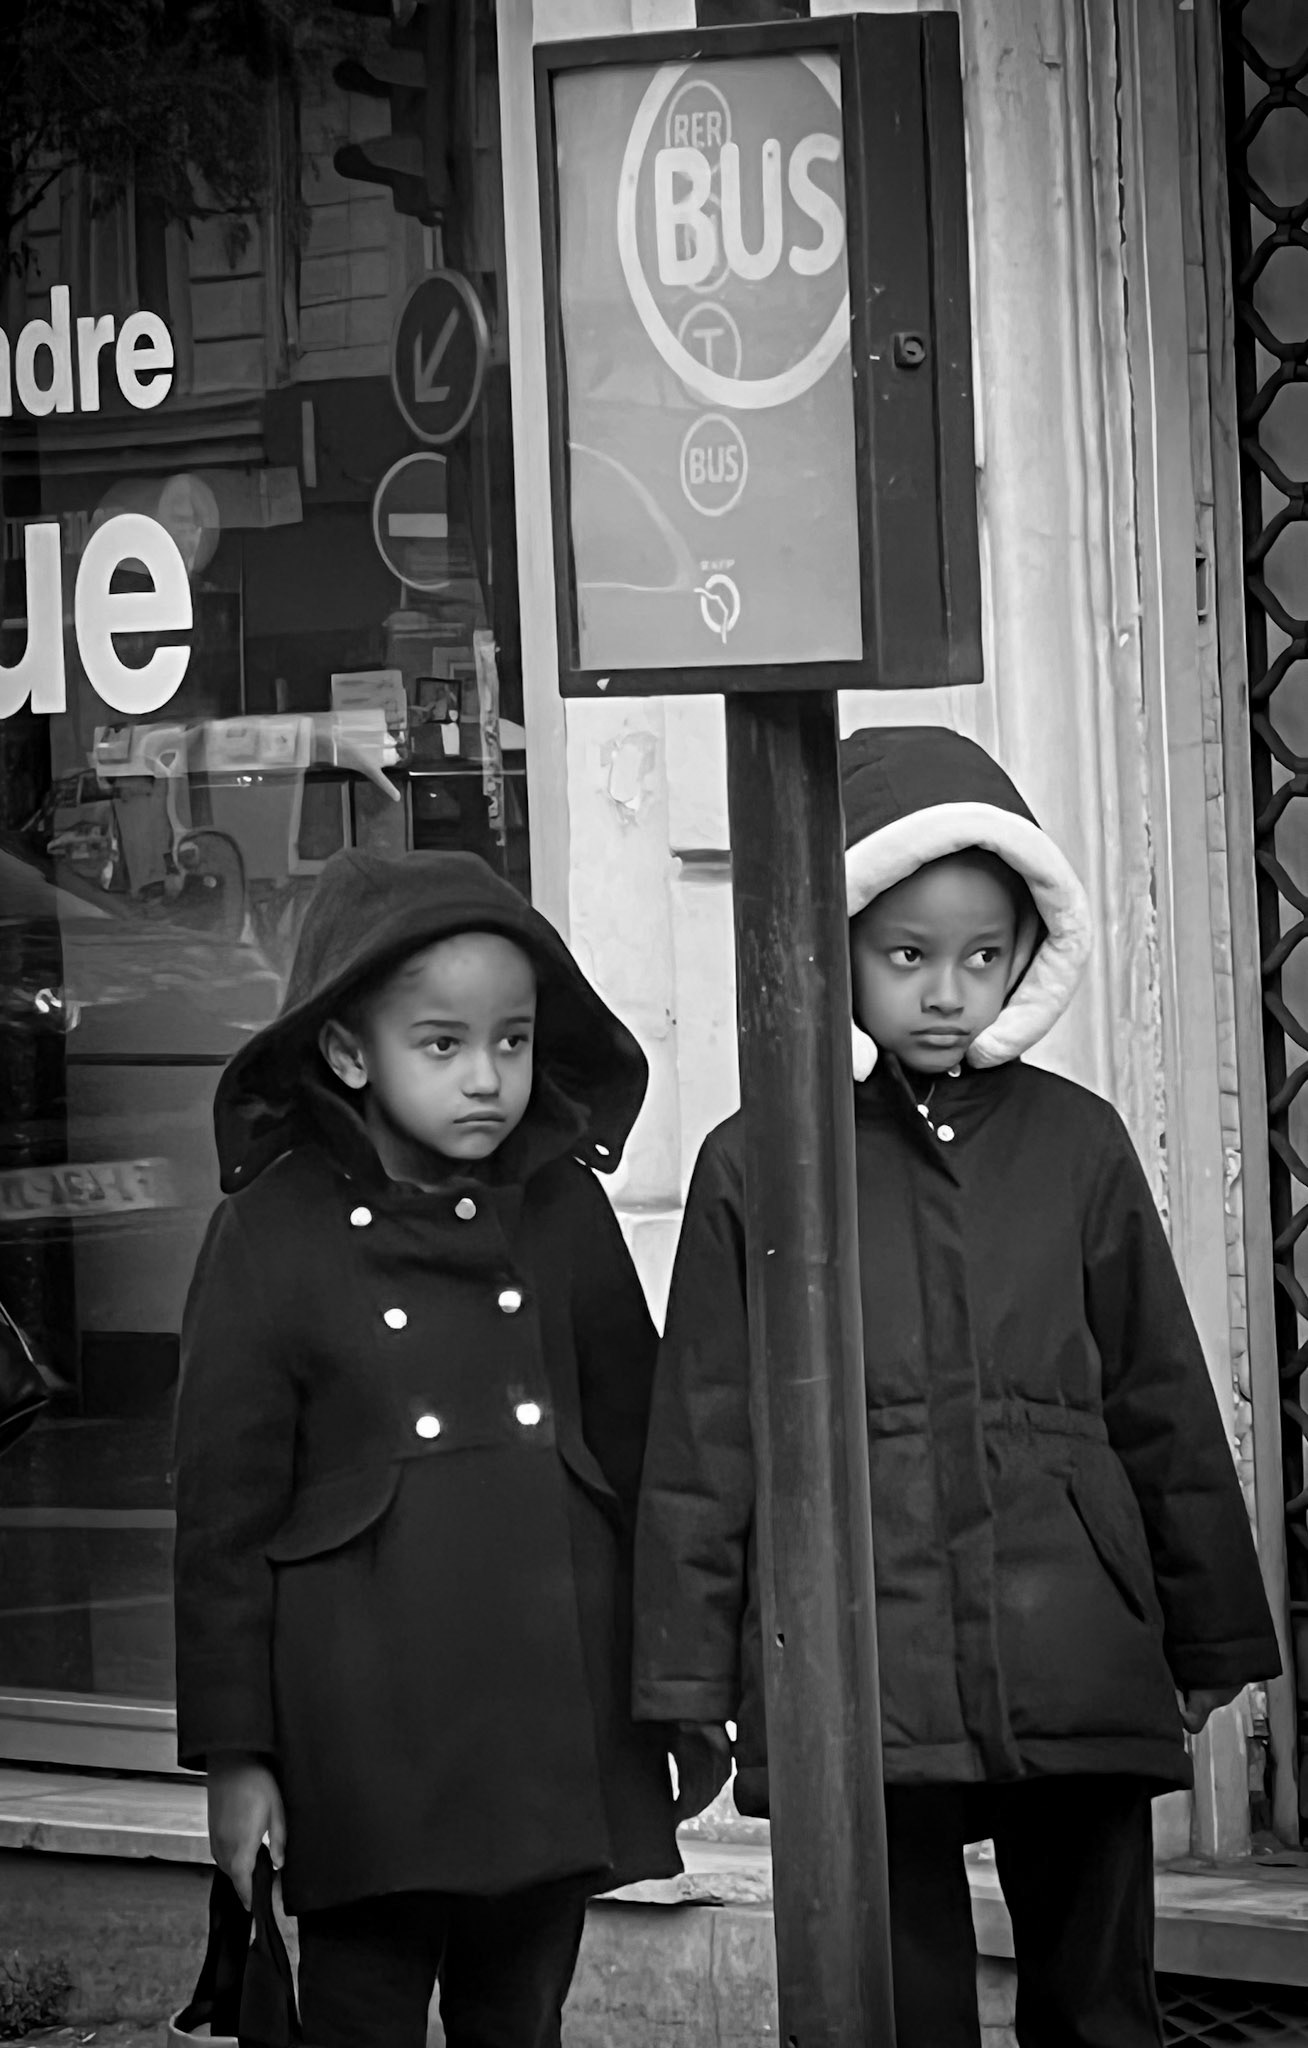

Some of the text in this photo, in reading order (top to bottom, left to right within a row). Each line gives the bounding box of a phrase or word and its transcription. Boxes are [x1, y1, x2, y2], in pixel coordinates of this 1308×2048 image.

[674, 111, 722, 147] RER
[655, 132, 844, 285] BUS
[0, 285, 174, 416] dre
[693, 328, 724, 370] T
[686, 446, 739, 484] BUS
